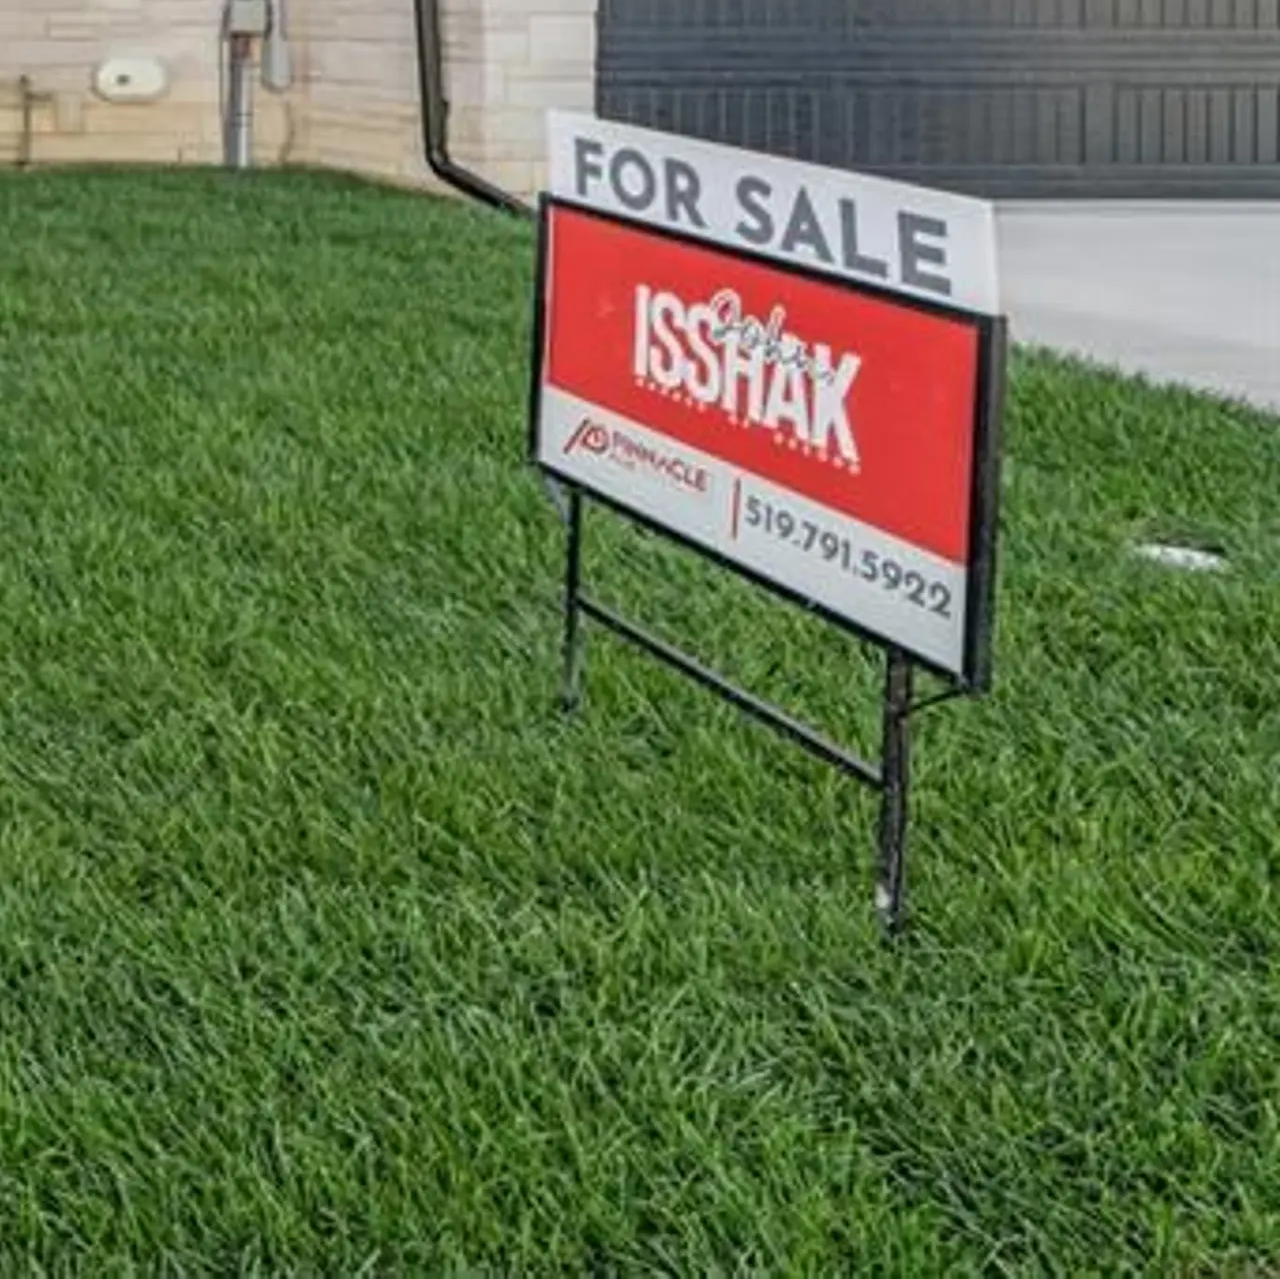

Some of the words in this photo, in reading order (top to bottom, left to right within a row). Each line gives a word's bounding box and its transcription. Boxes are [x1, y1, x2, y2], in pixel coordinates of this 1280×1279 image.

[574, 137, 706, 229] FOR
[735, 176, 951, 297] SALE
[635, 283, 861, 465] ISSHAK
[744, 495, 952, 618] 519.791.5922
